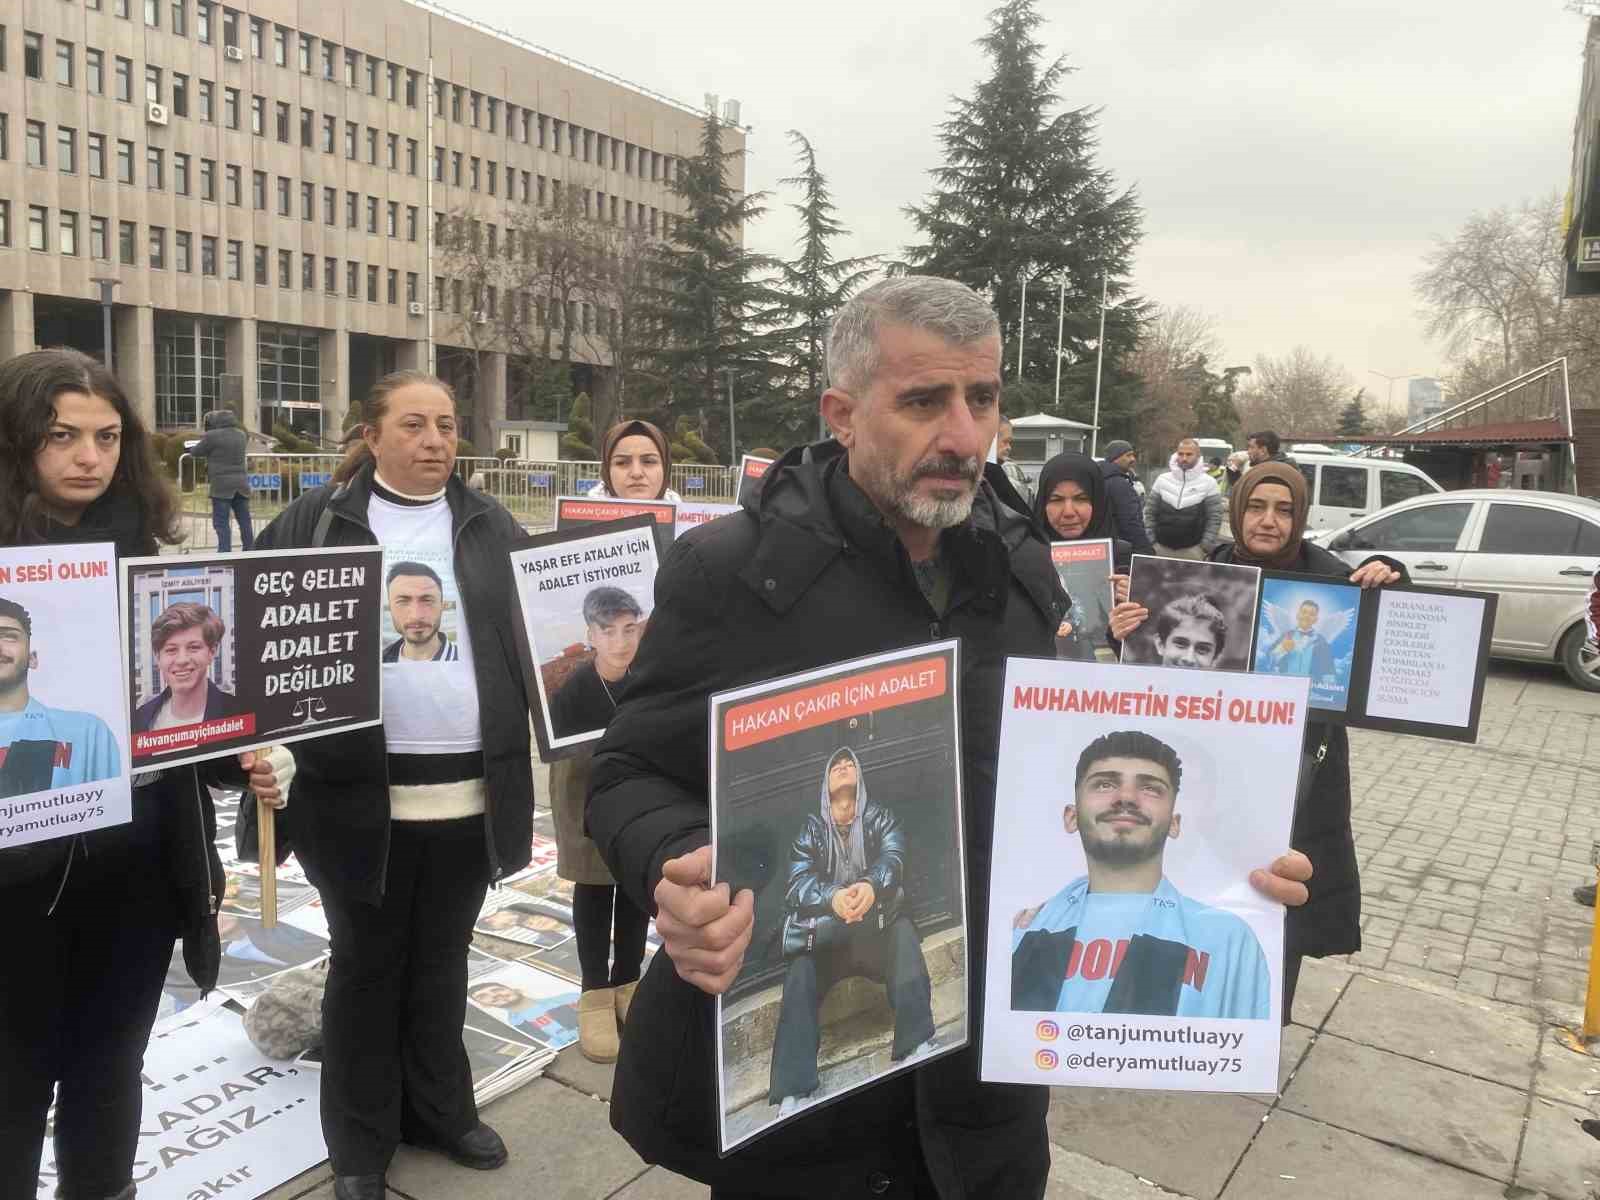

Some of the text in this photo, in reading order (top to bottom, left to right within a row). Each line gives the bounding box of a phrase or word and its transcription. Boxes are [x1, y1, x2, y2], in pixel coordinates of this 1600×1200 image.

[16, 558, 53, 582] SESİ
[57, 560, 109, 580] OLUN!
[520, 537, 650, 575] YAŞAR EFE ATALAY İÇİN
[254, 566, 365, 597] GEÇ GELEN
[538, 562, 642, 592] ADALET İSTİYORUZ
[260, 599, 359, 629] ADALET
[260, 631, 359, 663] ADALET
[265, 659, 355, 697] DEĞİLDİR
[732, 669, 937, 737] HAKAN ÇAKIR İÇİN ADALET
[1013, 685, 1296, 725] MUHAMMETİN SESİ OLUN!
[0, 789, 104, 819] njumutluayy
[0, 806, 104, 837] ryamutluay75
[1066, 1023, 1244, 1049] @tanjumutluayy
[1066, 1051, 1242, 1075] @deryamutluay75
[139, 1065, 299, 1138] ADAR,
[187, 1164, 256, 1200] akır
